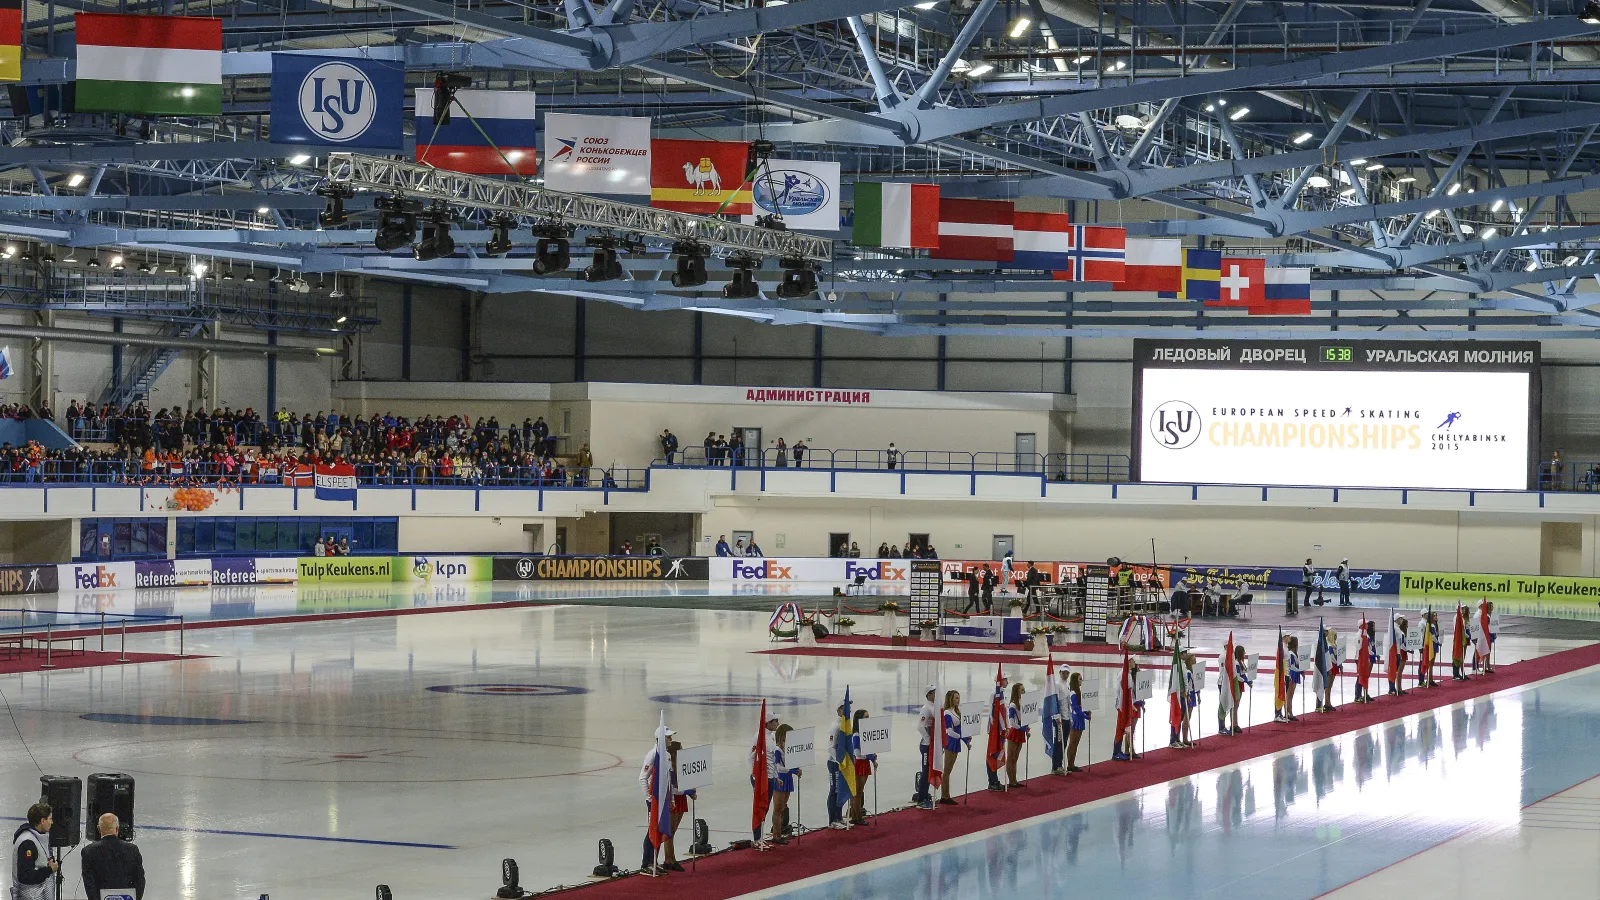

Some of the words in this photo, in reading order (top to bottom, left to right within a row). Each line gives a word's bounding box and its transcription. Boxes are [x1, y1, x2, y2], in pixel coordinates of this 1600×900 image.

[312, 76, 364, 134] ISU
[583, 137, 609, 145] СОЮЗ
[579, 147, 648, 156] КОНЬКОБЕЖЦЕВ
[576, 156, 611, 164] РОССИИ
[1152, 346, 1231, 362] ЛЕДОВЫЙ
[1239, 348, 1307, 363] ДВОРЕЦ
[1366, 350, 1459, 363] УРАЛЬСКАЯ
[1464, 350, 1534, 363] МОЛНИЯ
[746, 389, 870, 404] АДМИНИСТРАЦИЯ
[1212, 407, 1284, 417] EUROPEAN
[1294, 409, 1336, 417] SPEED
[1360, 409, 1420, 418] SKATING
[1159, 410, 1194, 445] ISU
[1208, 421, 1421, 449] CHAMPIONSHIPS
[1431, 434, 1507, 442] CHELYABINSK
[316, 476, 354, 488] ELSPEET
[212, 568, 256, 584] Referee
[436, 560, 467, 578] kpn
[537, 559, 662, 578] CHAMPIONSHIPS
[732, 560, 792, 580] FedEx
[845, 561, 906, 580] FedEx
[74, 566, 117, 589] FedEx
[136, 570, 175, 588] Referee
[953, 627, 960, 635] 2
[963, 713, 981, 725] POLAND
[862, 728, 889, 742] SWEDEN
[786, 742, 814, 755] SWITZERLAND
[682, 758, 708, 776] RUSSIA
